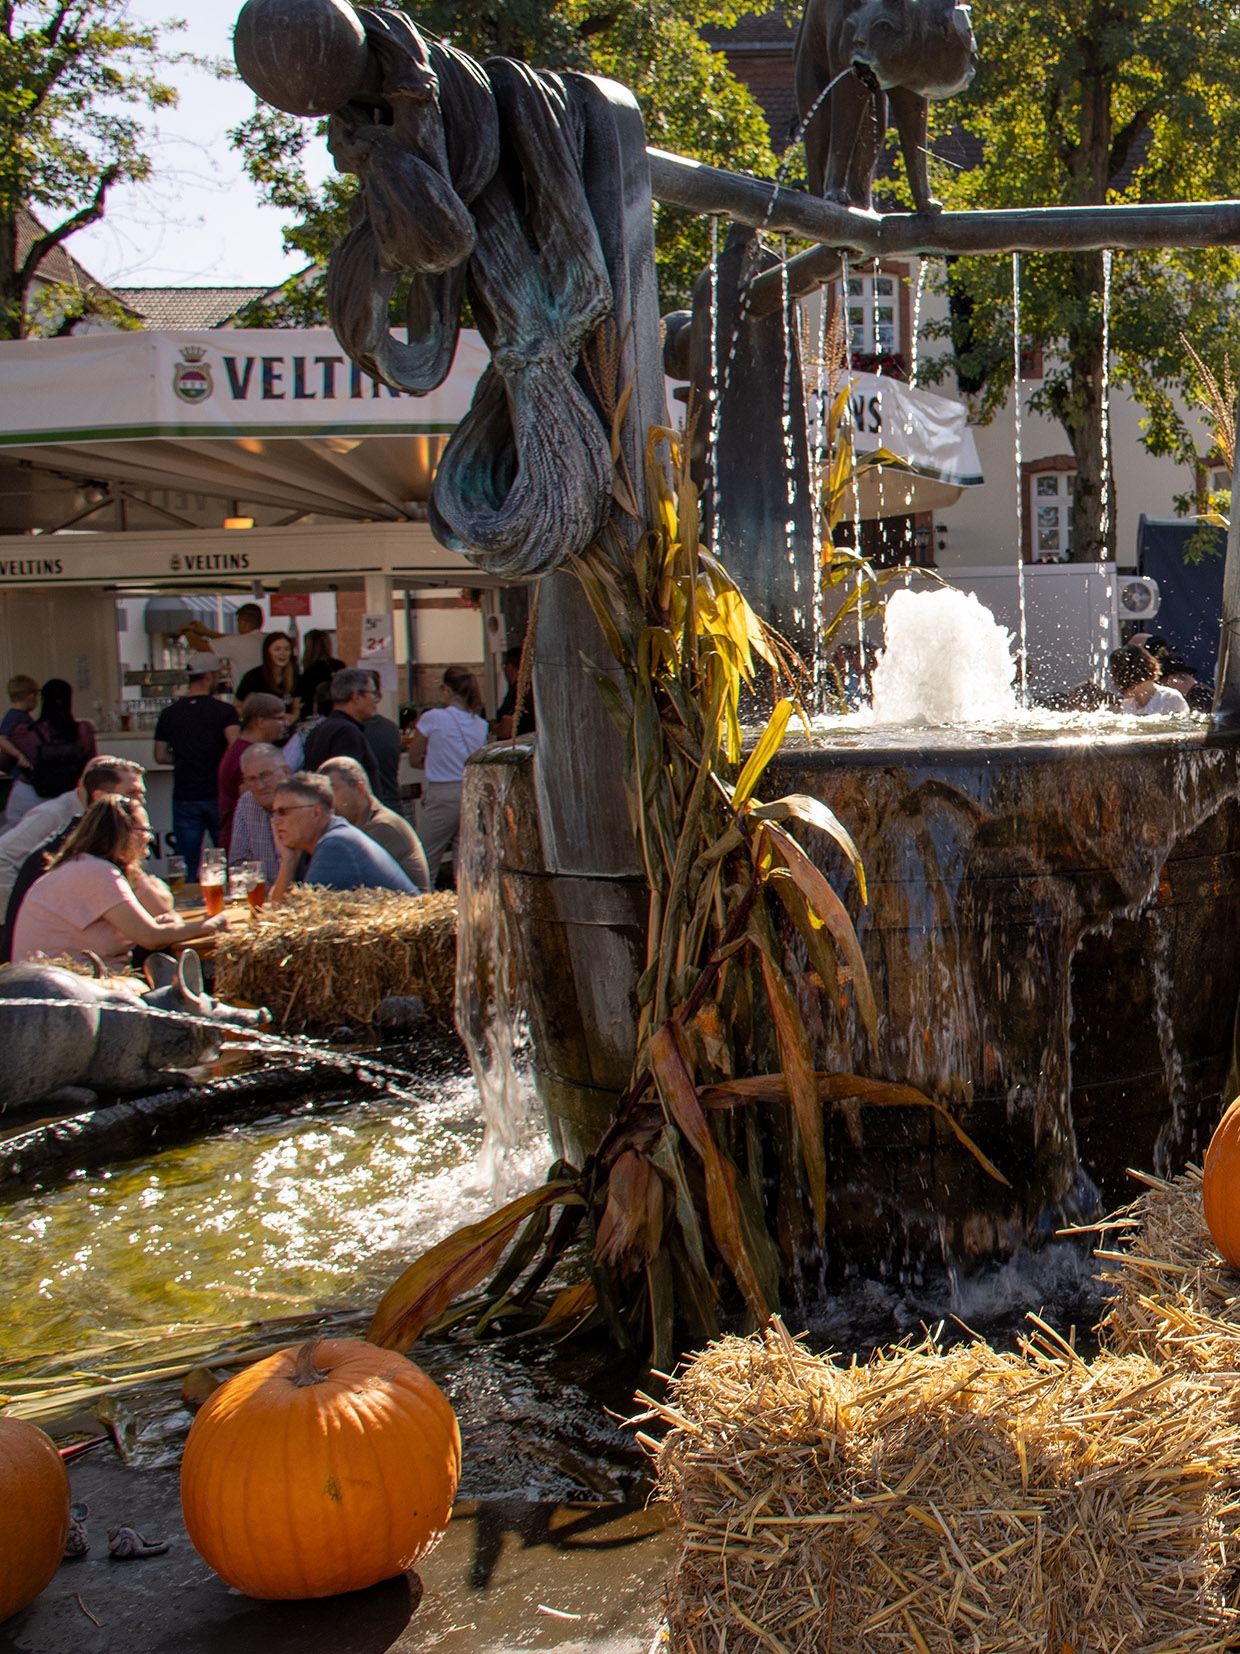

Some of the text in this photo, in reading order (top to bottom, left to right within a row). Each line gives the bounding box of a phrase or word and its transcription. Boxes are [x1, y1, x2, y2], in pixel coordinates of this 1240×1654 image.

[222, 356, 425, 400] VELTI
[0, 559, 63, 576] VELTINS
[184, 553, 250, 571] VELTINS
